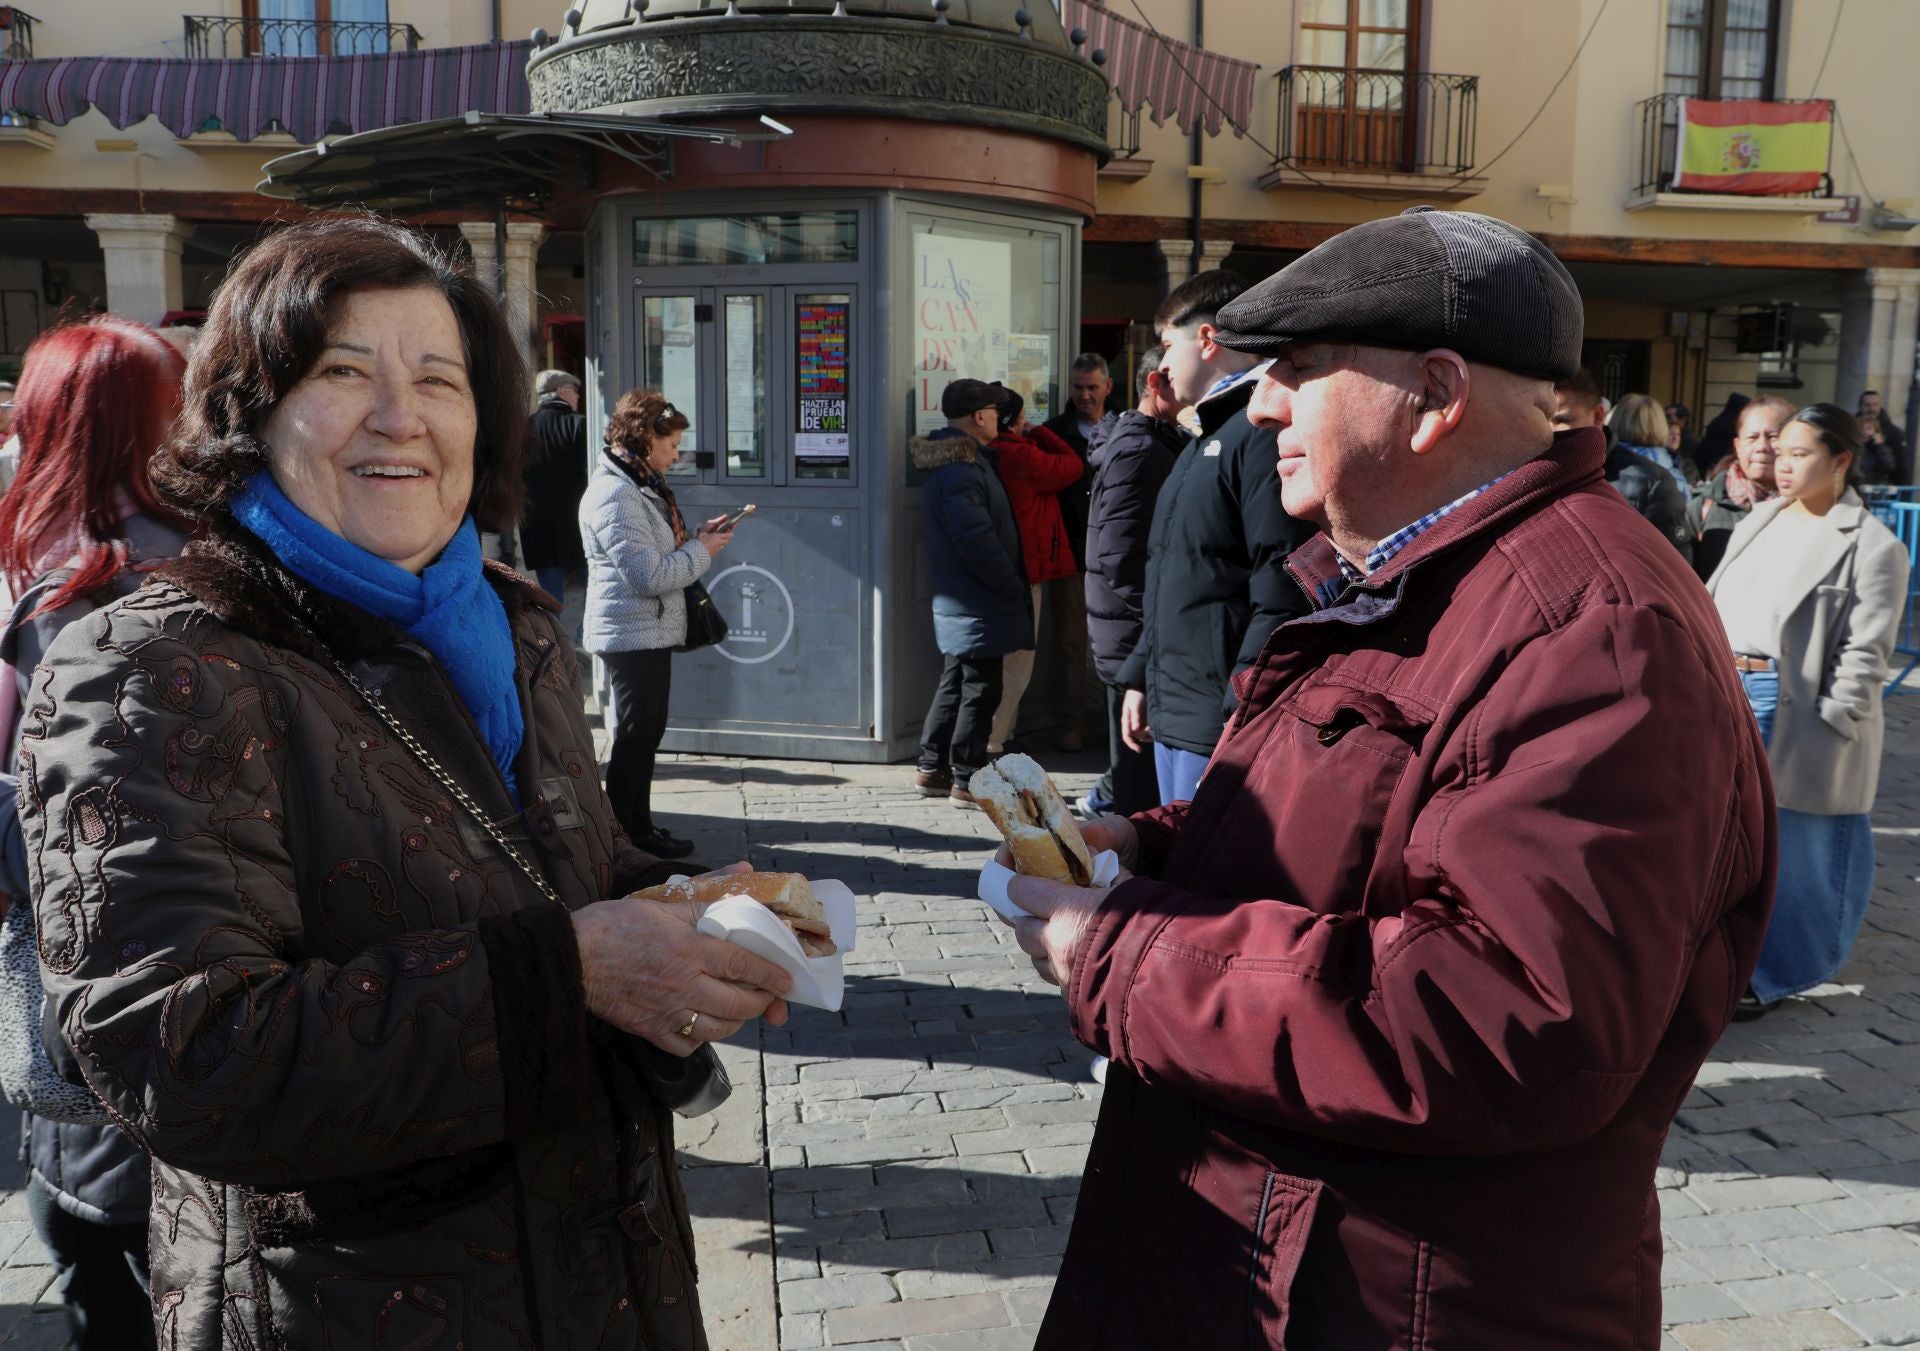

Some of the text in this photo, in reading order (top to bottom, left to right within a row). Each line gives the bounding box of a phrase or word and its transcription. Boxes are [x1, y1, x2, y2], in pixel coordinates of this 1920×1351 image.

[920, 254, 971, 311] LAS
[920, 298, 981, 333] CAN
[921, 339, 957, 371] DE
[805, 408, 841, 417] PRUEBA
[831, 400, 841, 408] LA
[805, 416, 820, 429] DE
